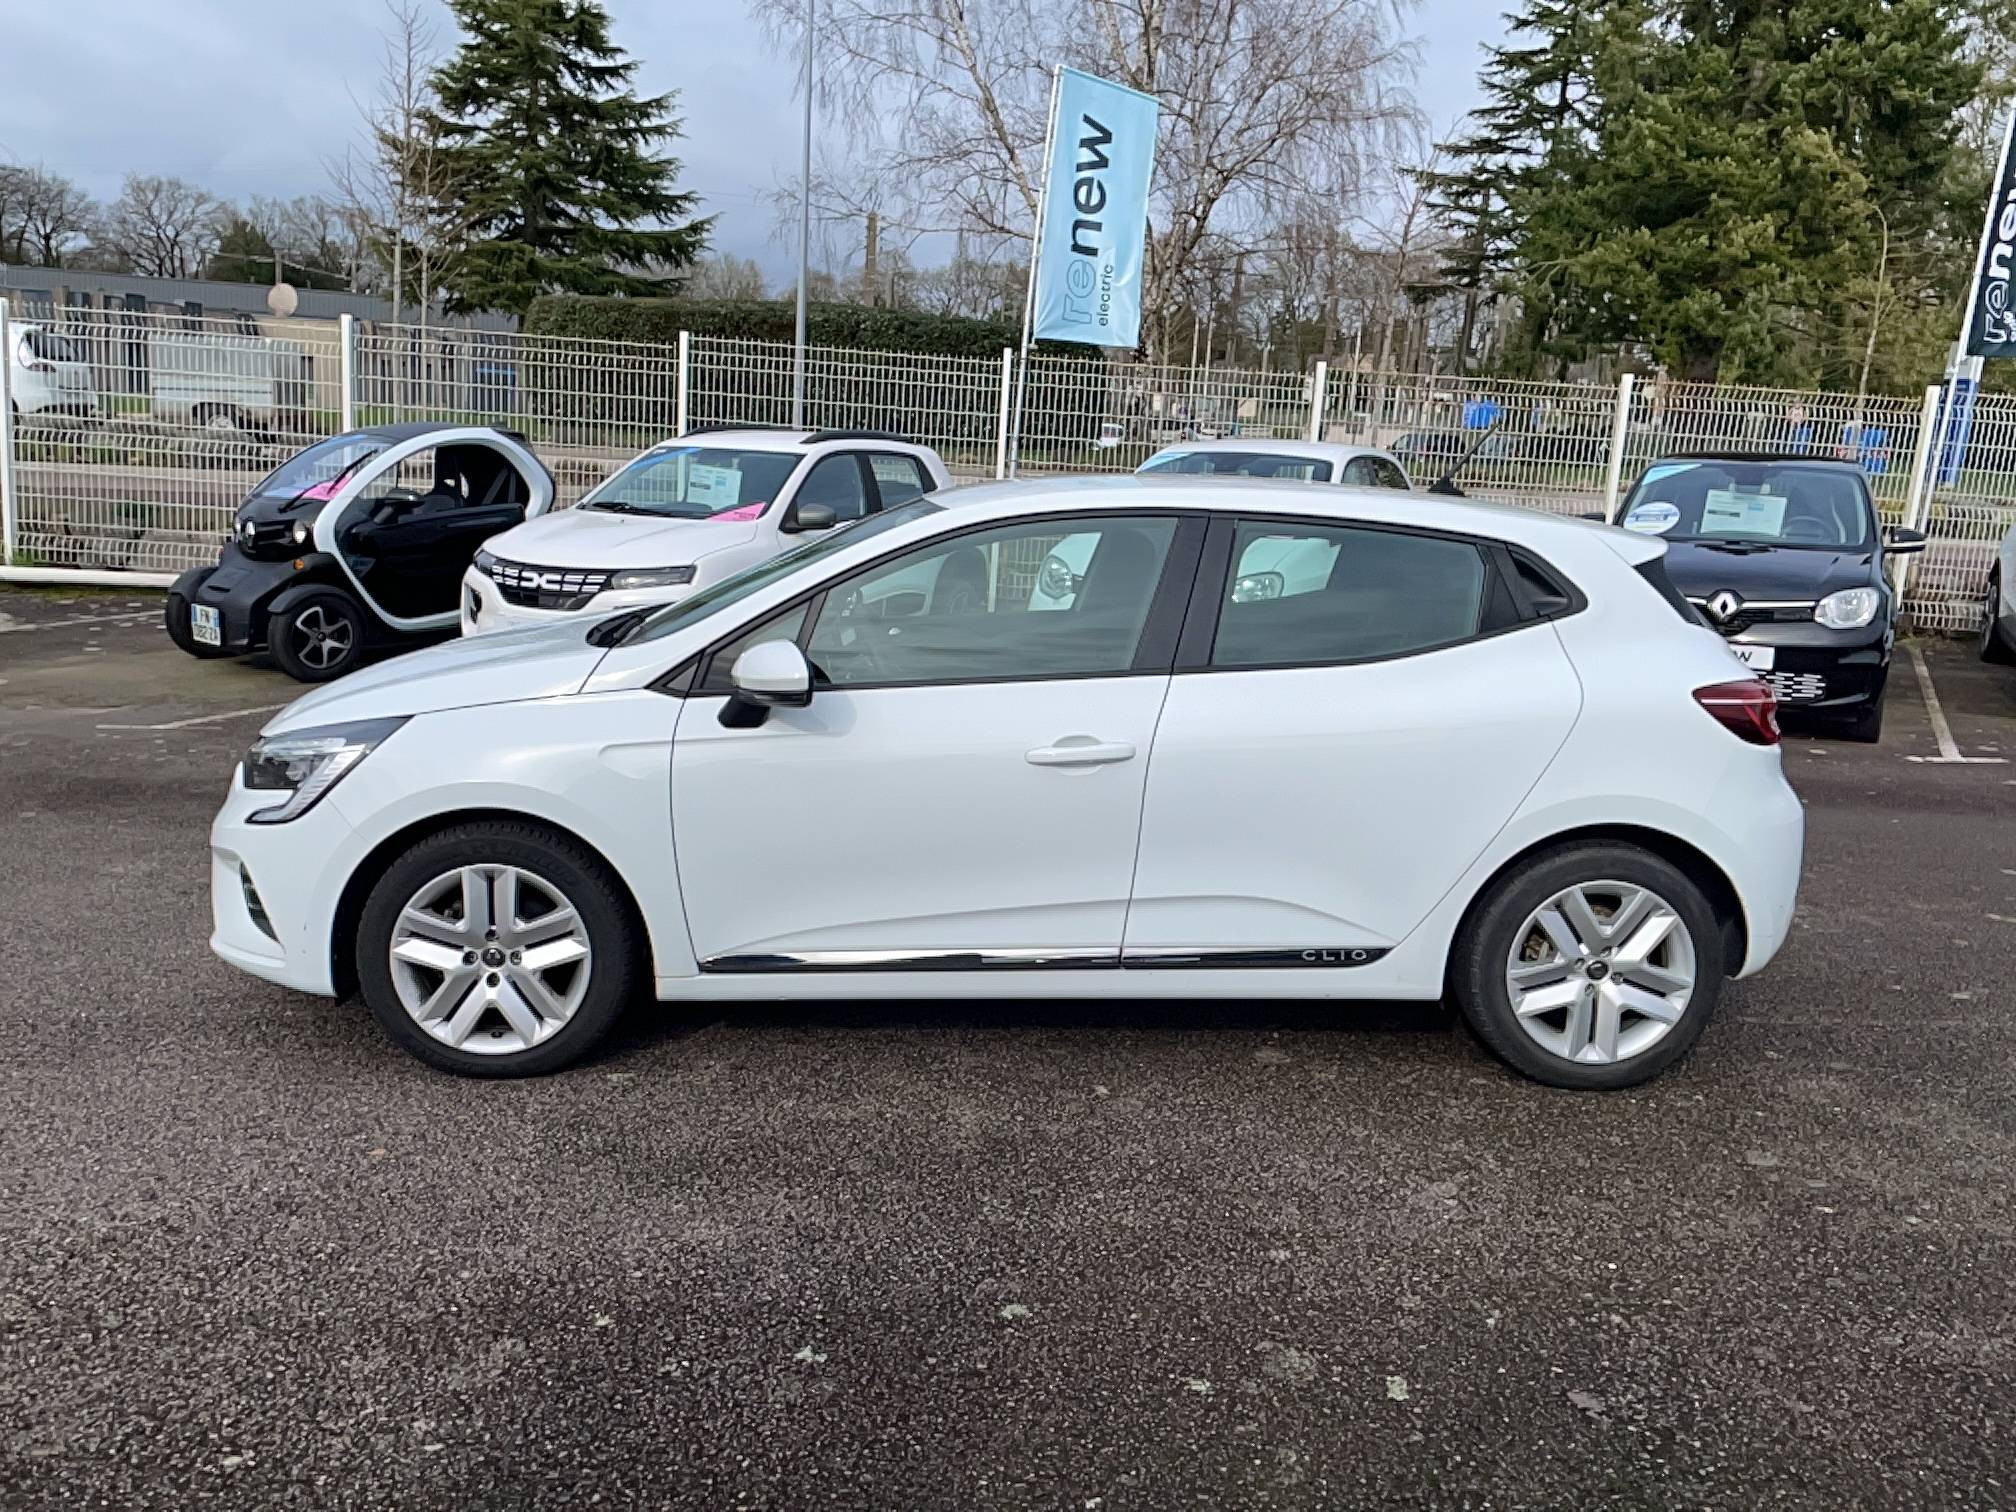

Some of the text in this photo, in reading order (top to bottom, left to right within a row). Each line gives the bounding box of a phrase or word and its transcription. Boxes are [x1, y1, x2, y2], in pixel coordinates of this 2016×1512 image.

[1061, 113, 1113, 325] renew
[1098, 263, 1115, 328] electric
[1302, 949, 1368, 961] CLIO
